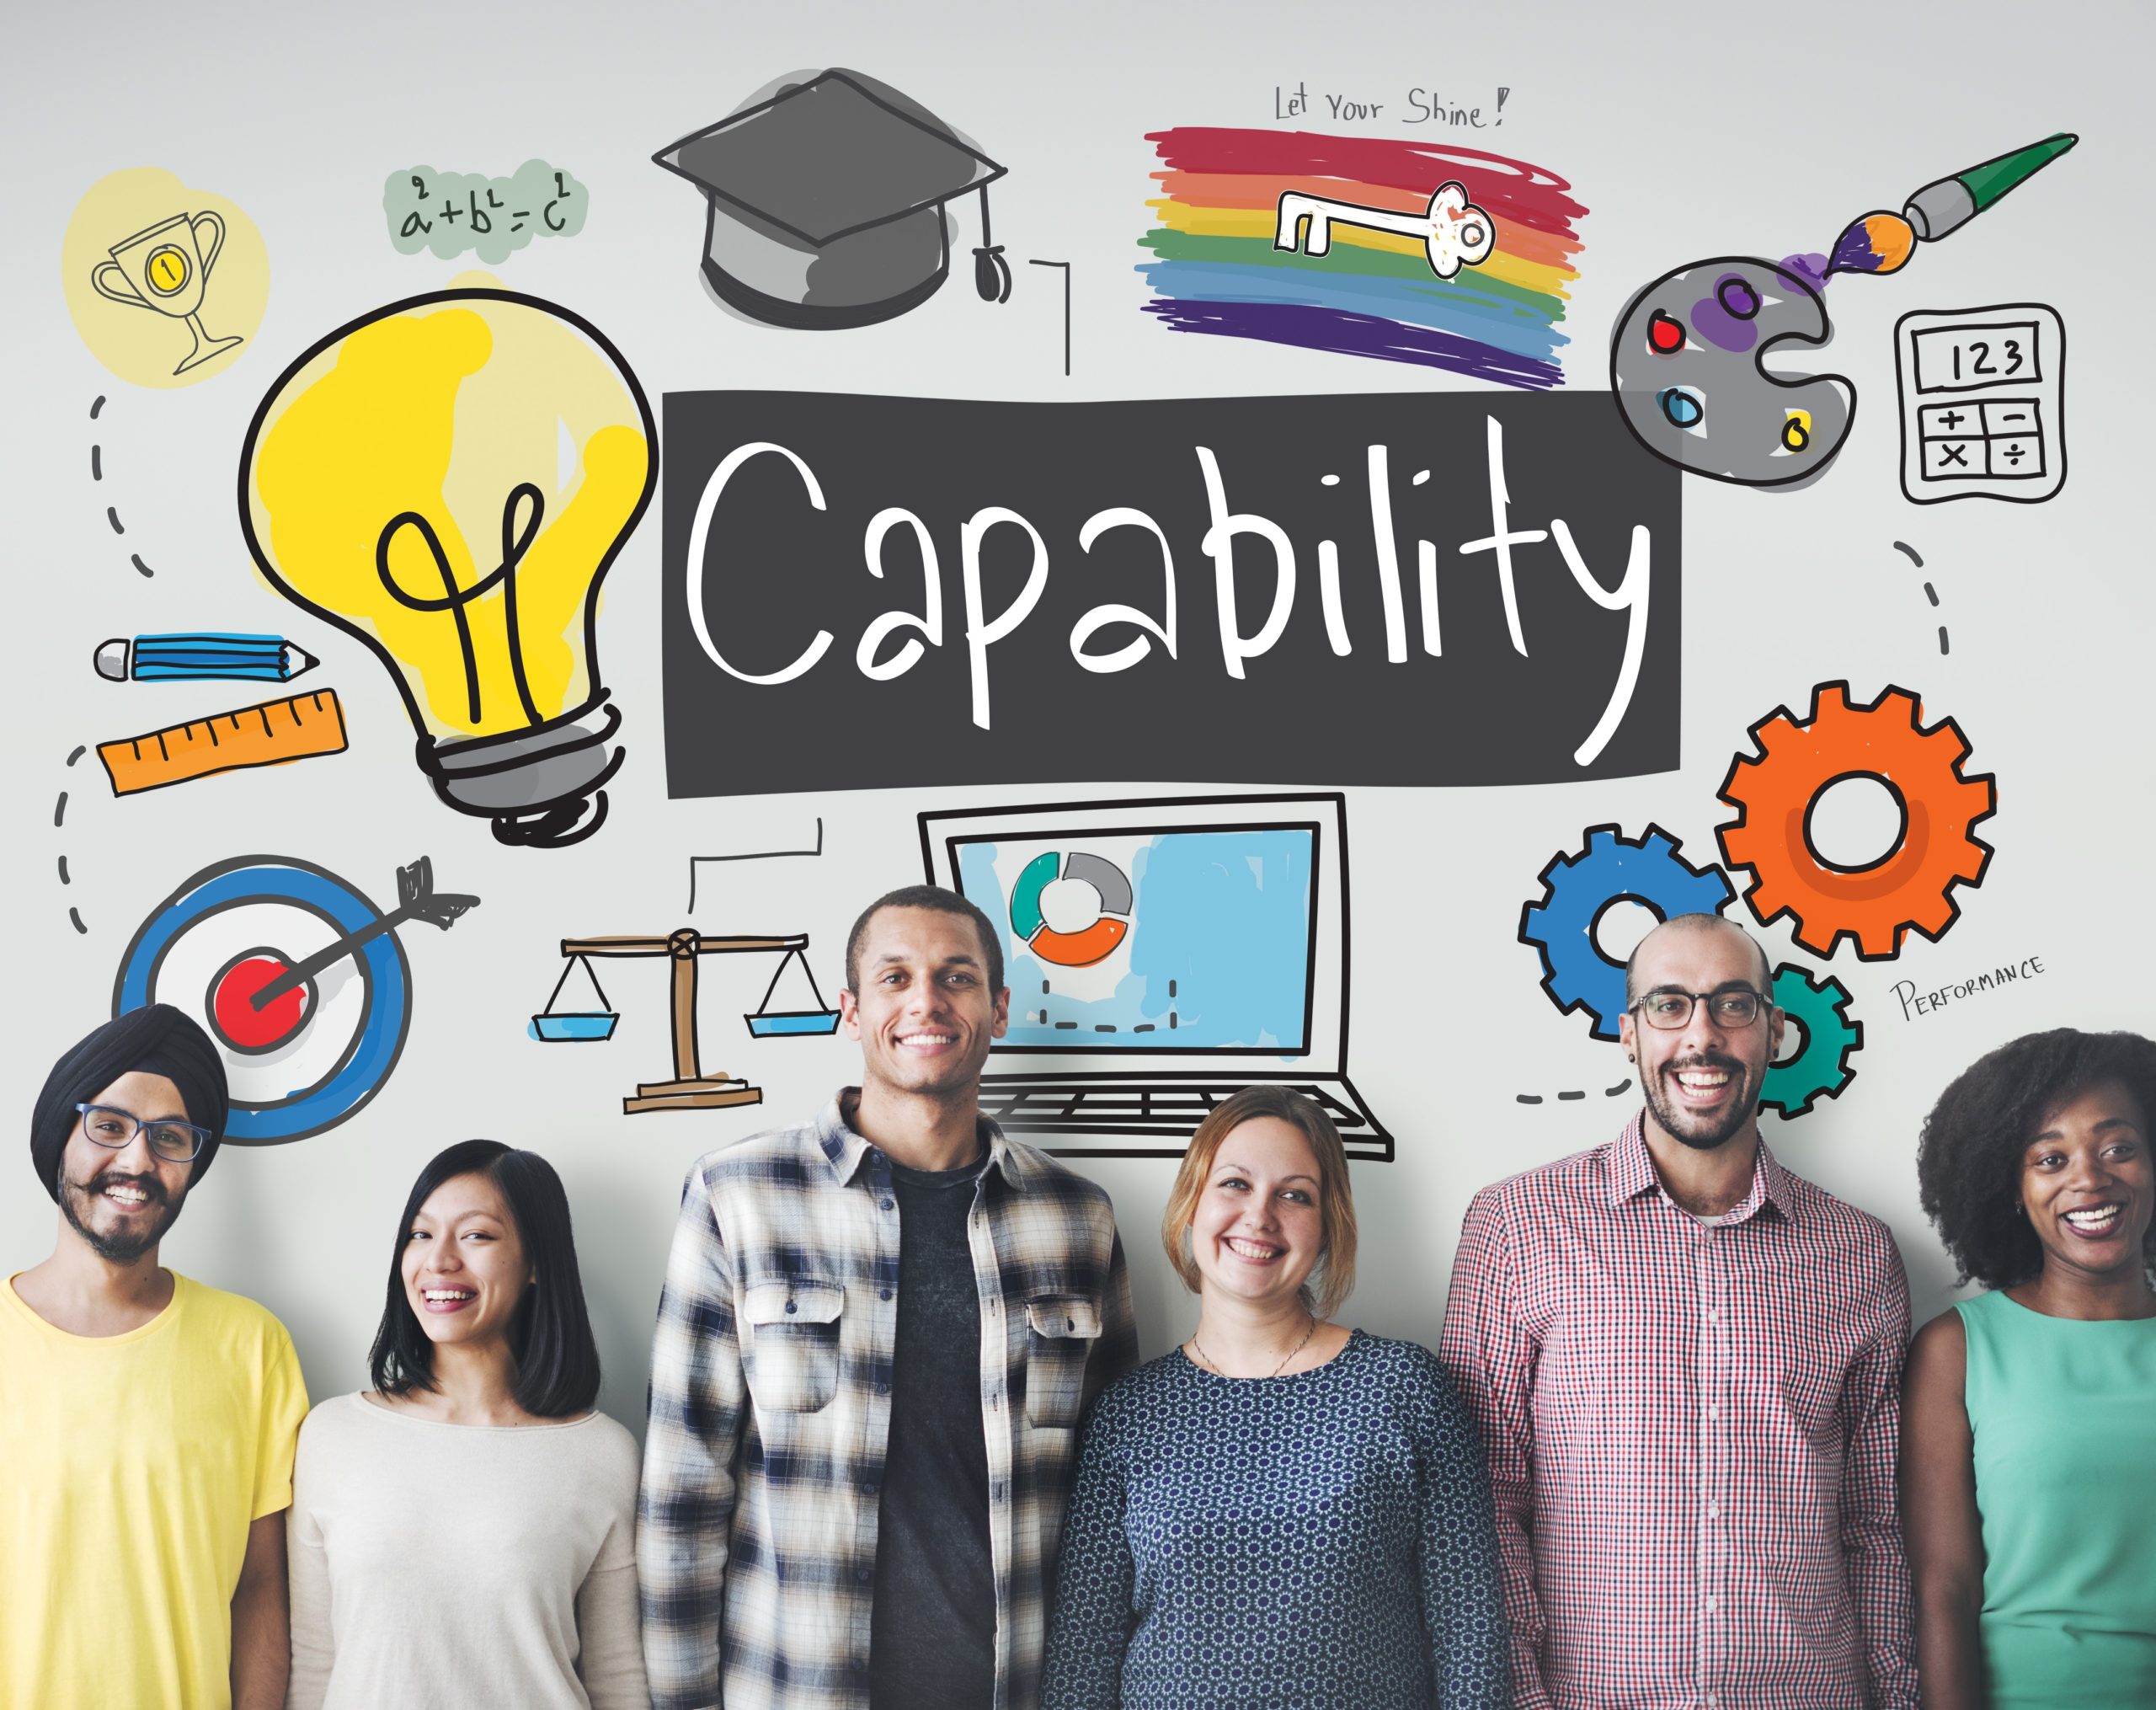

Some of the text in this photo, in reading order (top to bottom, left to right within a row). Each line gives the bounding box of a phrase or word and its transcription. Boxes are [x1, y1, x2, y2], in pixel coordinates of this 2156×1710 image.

[1275, 81, 1308, 120] Let
[1401, 87, 1511, 128] Shine!
[1953, 339, 2024, 381] 123
[686, 414, 1651, 767] Capability
[1888, 956, 2046, 1022] PERFORMANCE
